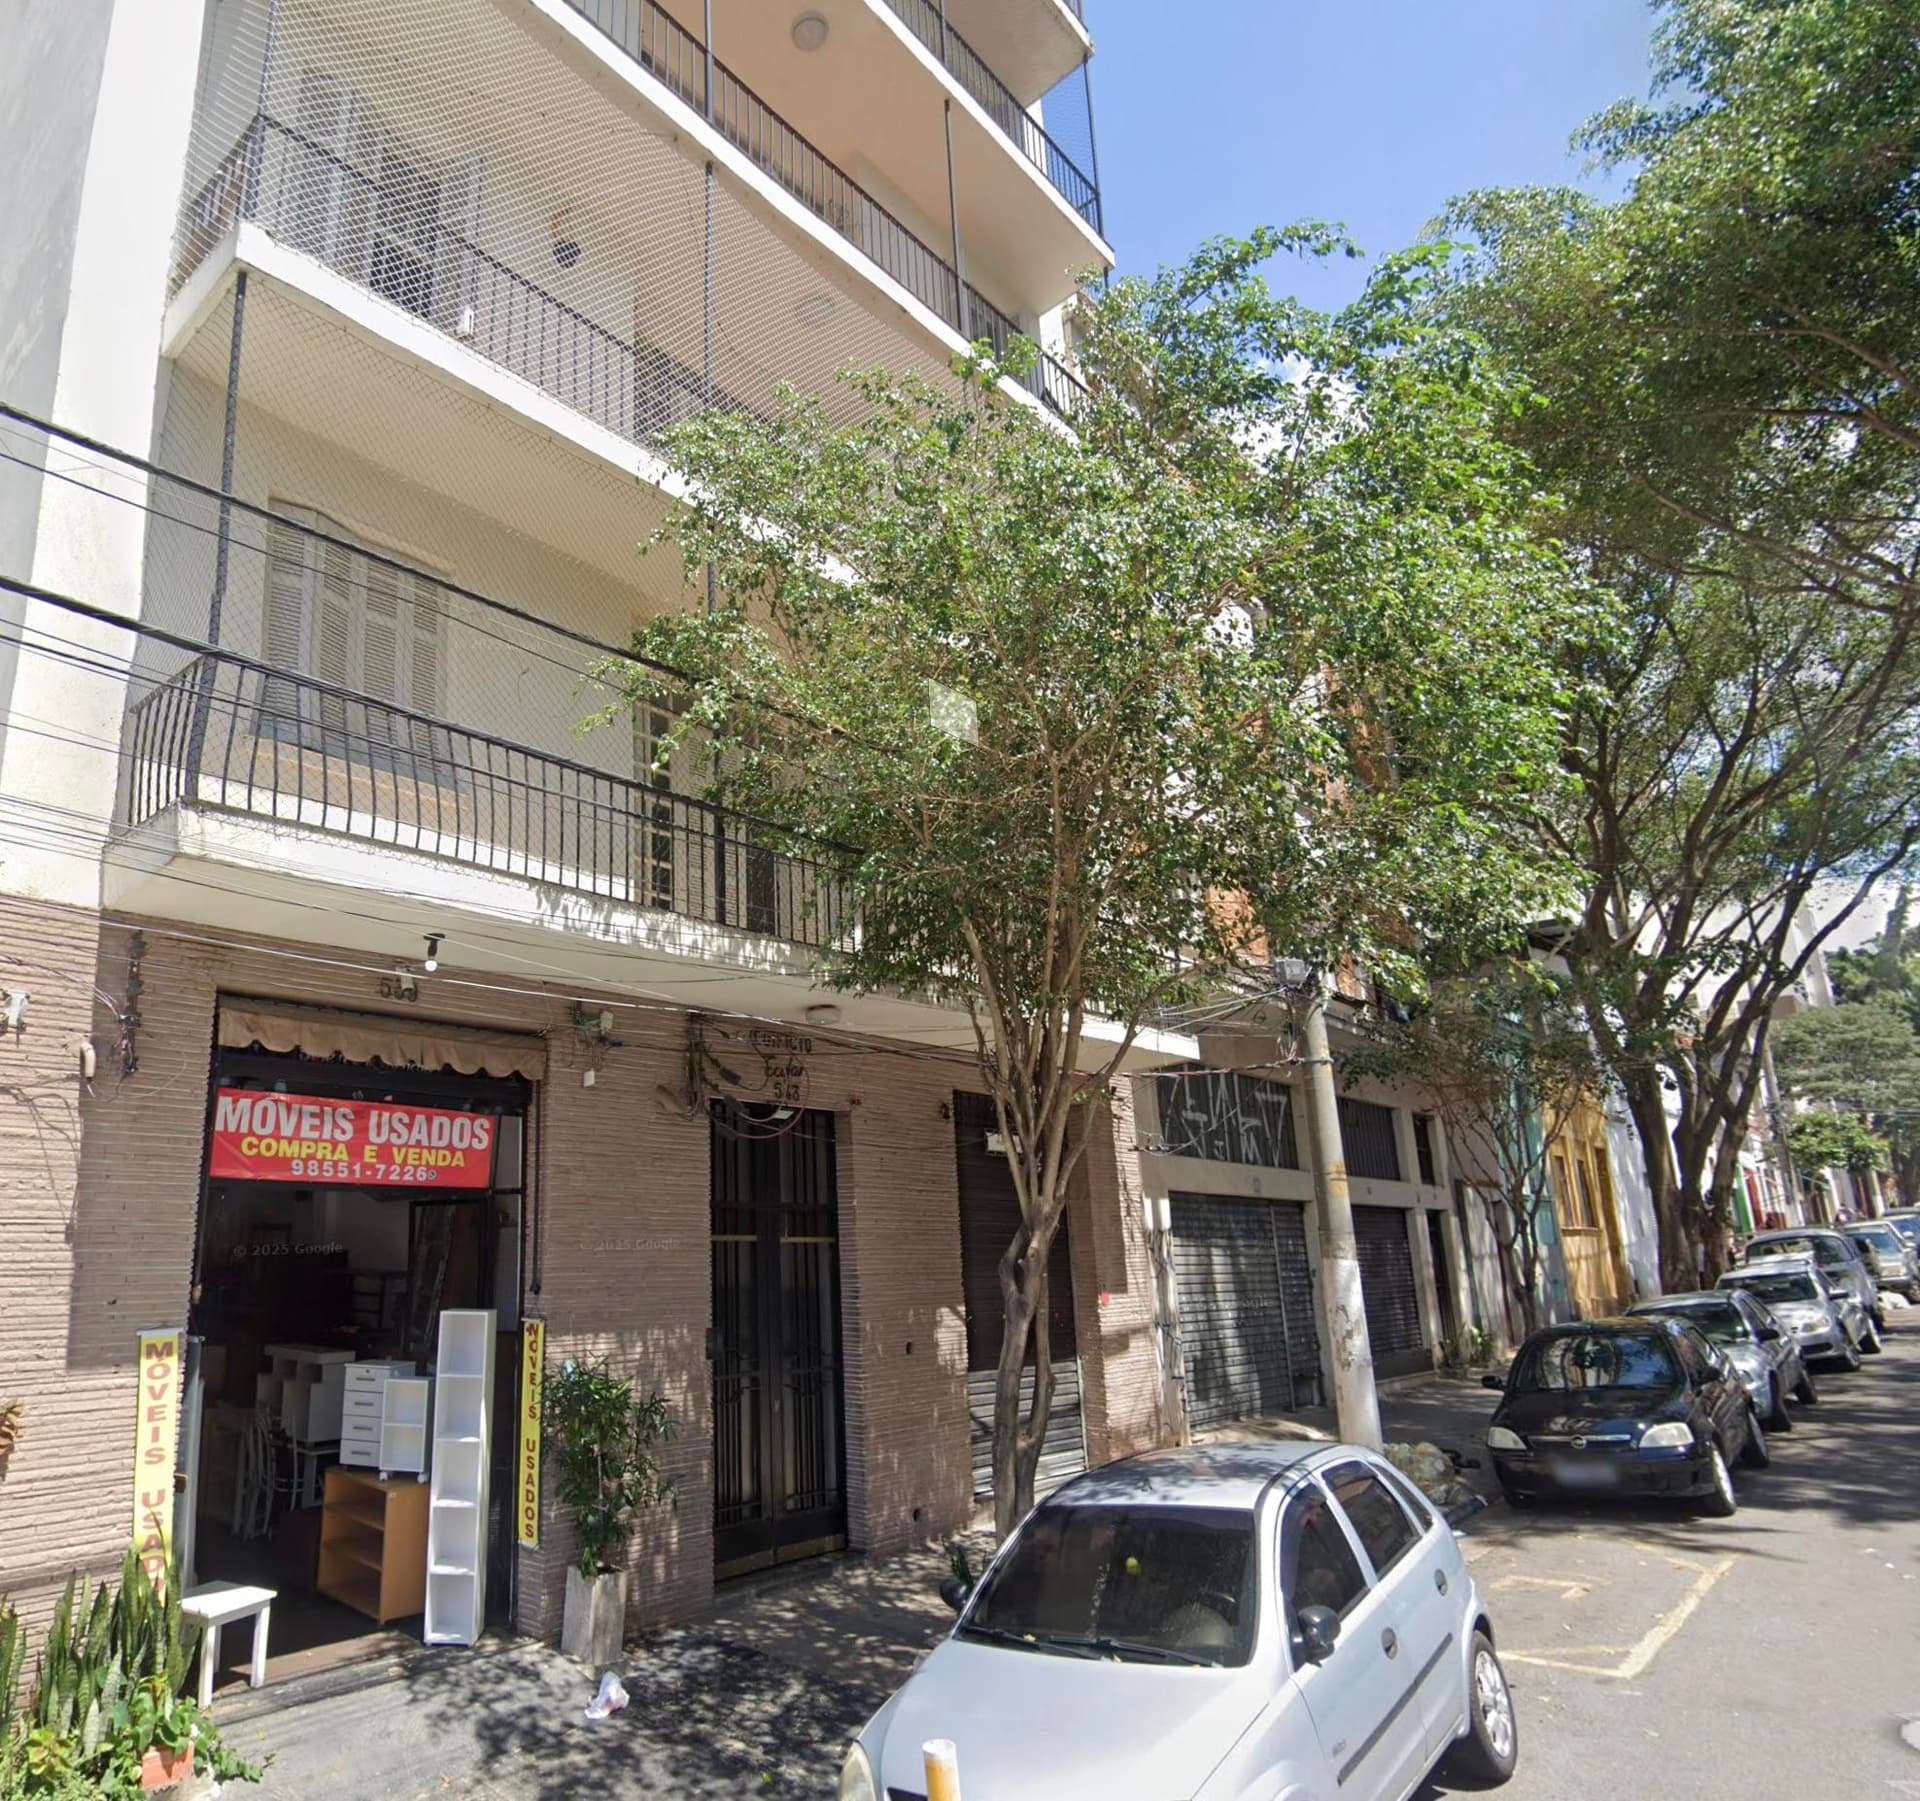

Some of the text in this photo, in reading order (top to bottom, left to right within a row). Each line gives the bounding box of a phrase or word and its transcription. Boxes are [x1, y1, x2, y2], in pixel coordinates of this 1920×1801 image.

[215, 1095, 490, 1149] MÓVEIS USADOS
[240, 1136, 465, 1167] COMPRA E VENDA
[290, 1160, 428, 1181] 98551-7226
[524, 1438, 536, 1538] USADOS
